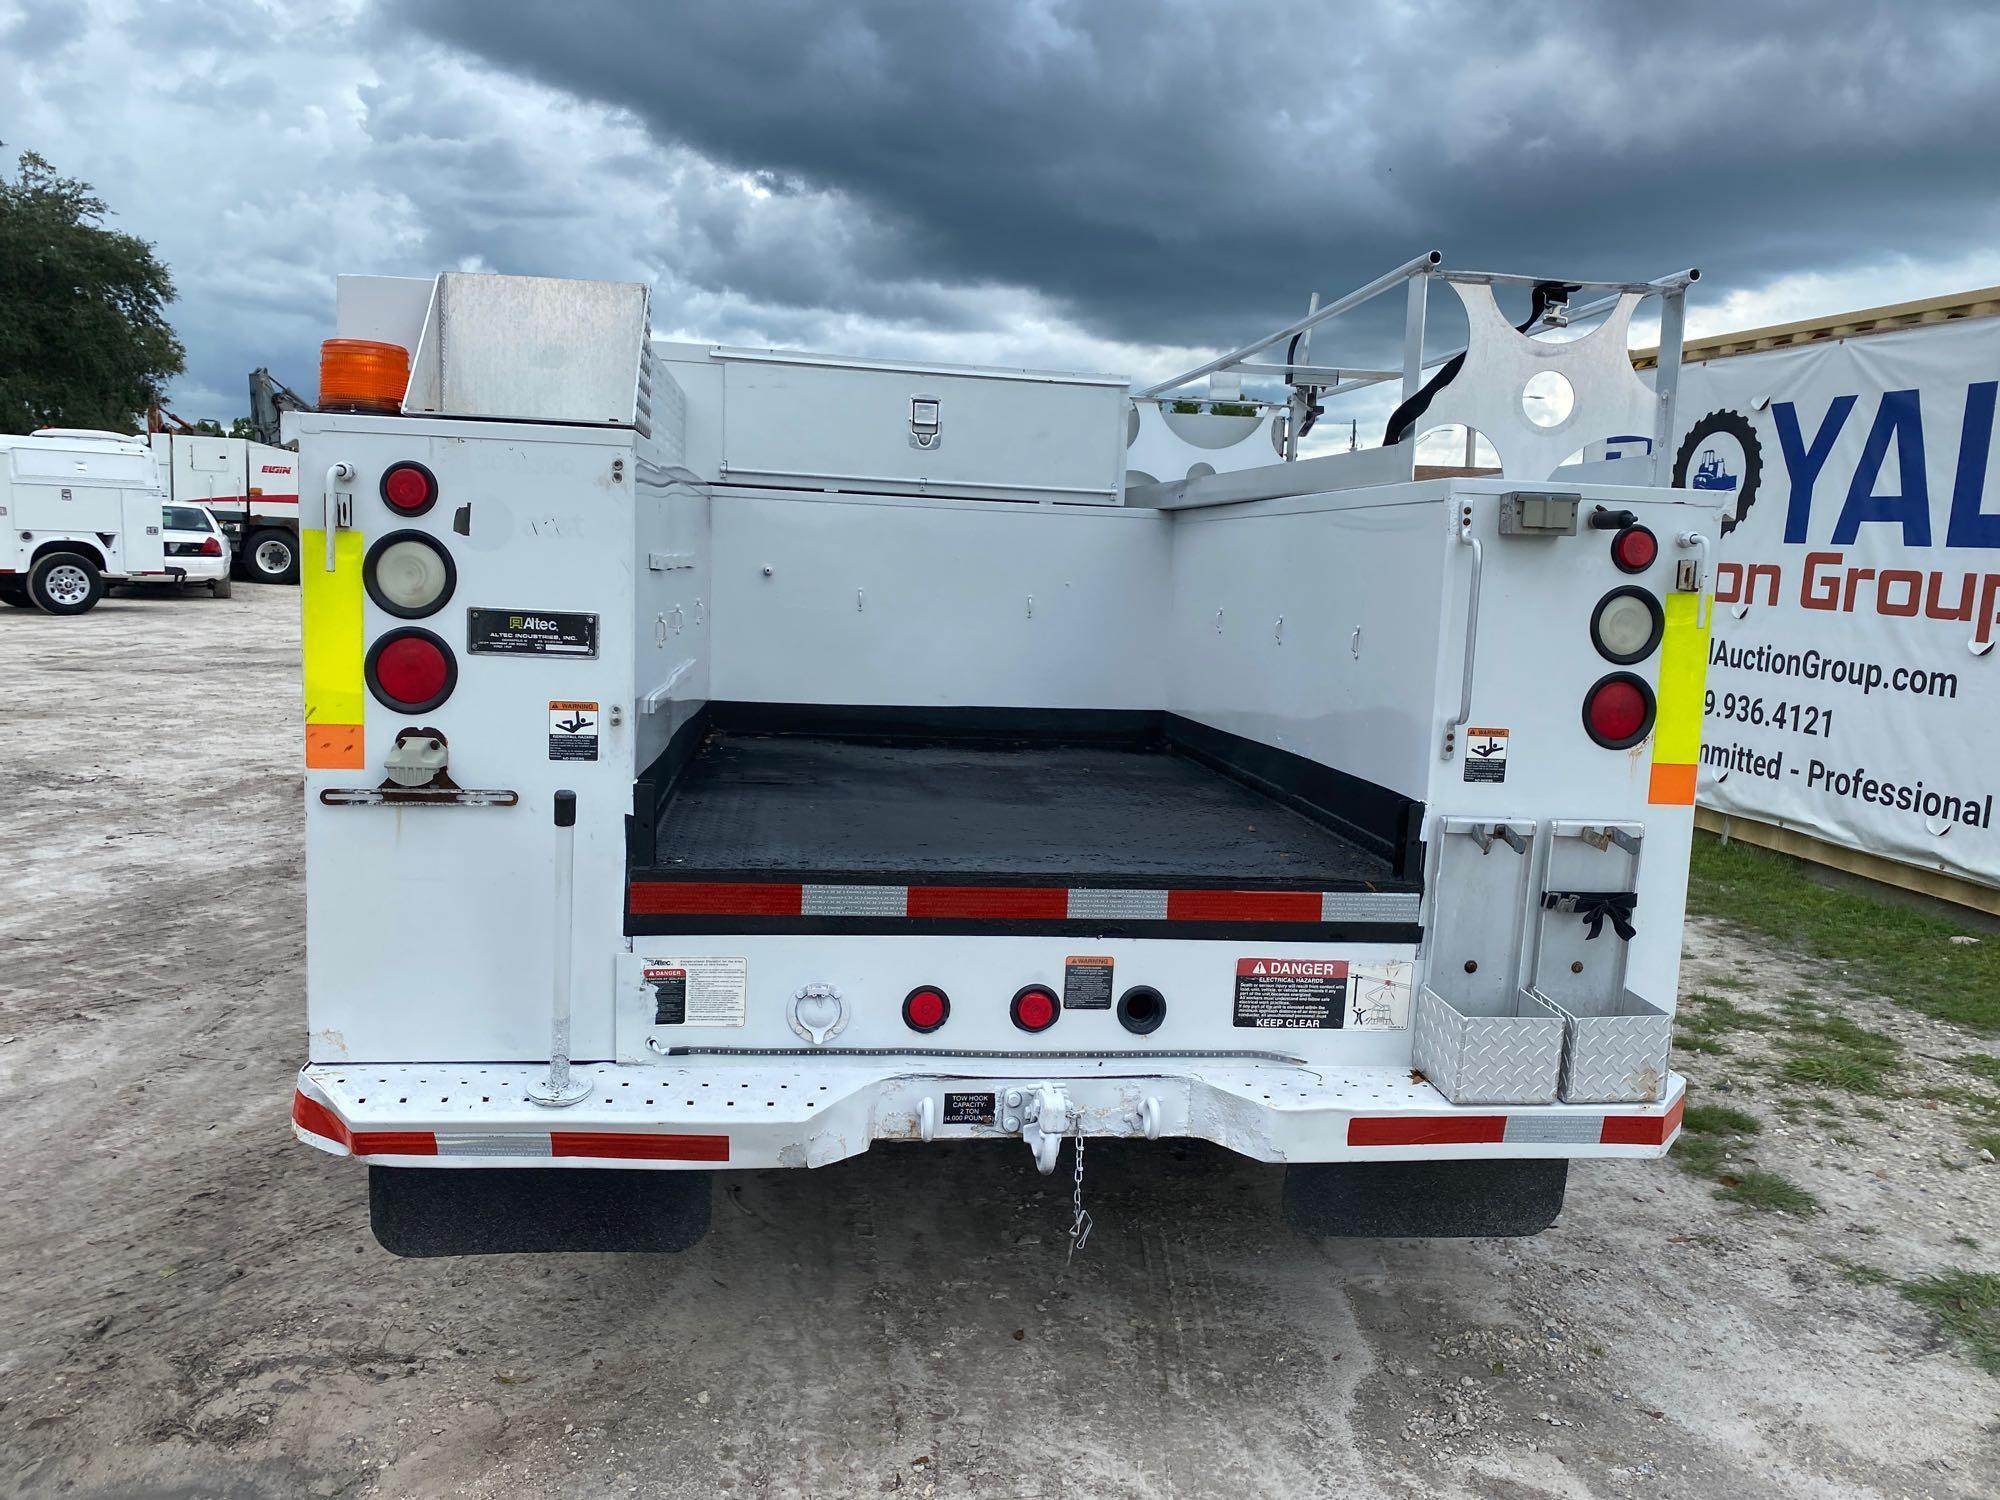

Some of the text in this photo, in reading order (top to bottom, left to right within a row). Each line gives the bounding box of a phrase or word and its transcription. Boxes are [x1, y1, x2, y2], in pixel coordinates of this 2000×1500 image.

[262, 465, 291, 474] ELGIN
[1800, 552, 2000, 643] Group
[523, 617, 558, 631] Altec
[514, 633, 561, 641] INDUSTRIES,
[1807, 759, 1993, 829] Professional
[1270, 962, 1334, 976] DANGER
[1256, 1018, 1320, 1028] KEEP CLEAR
